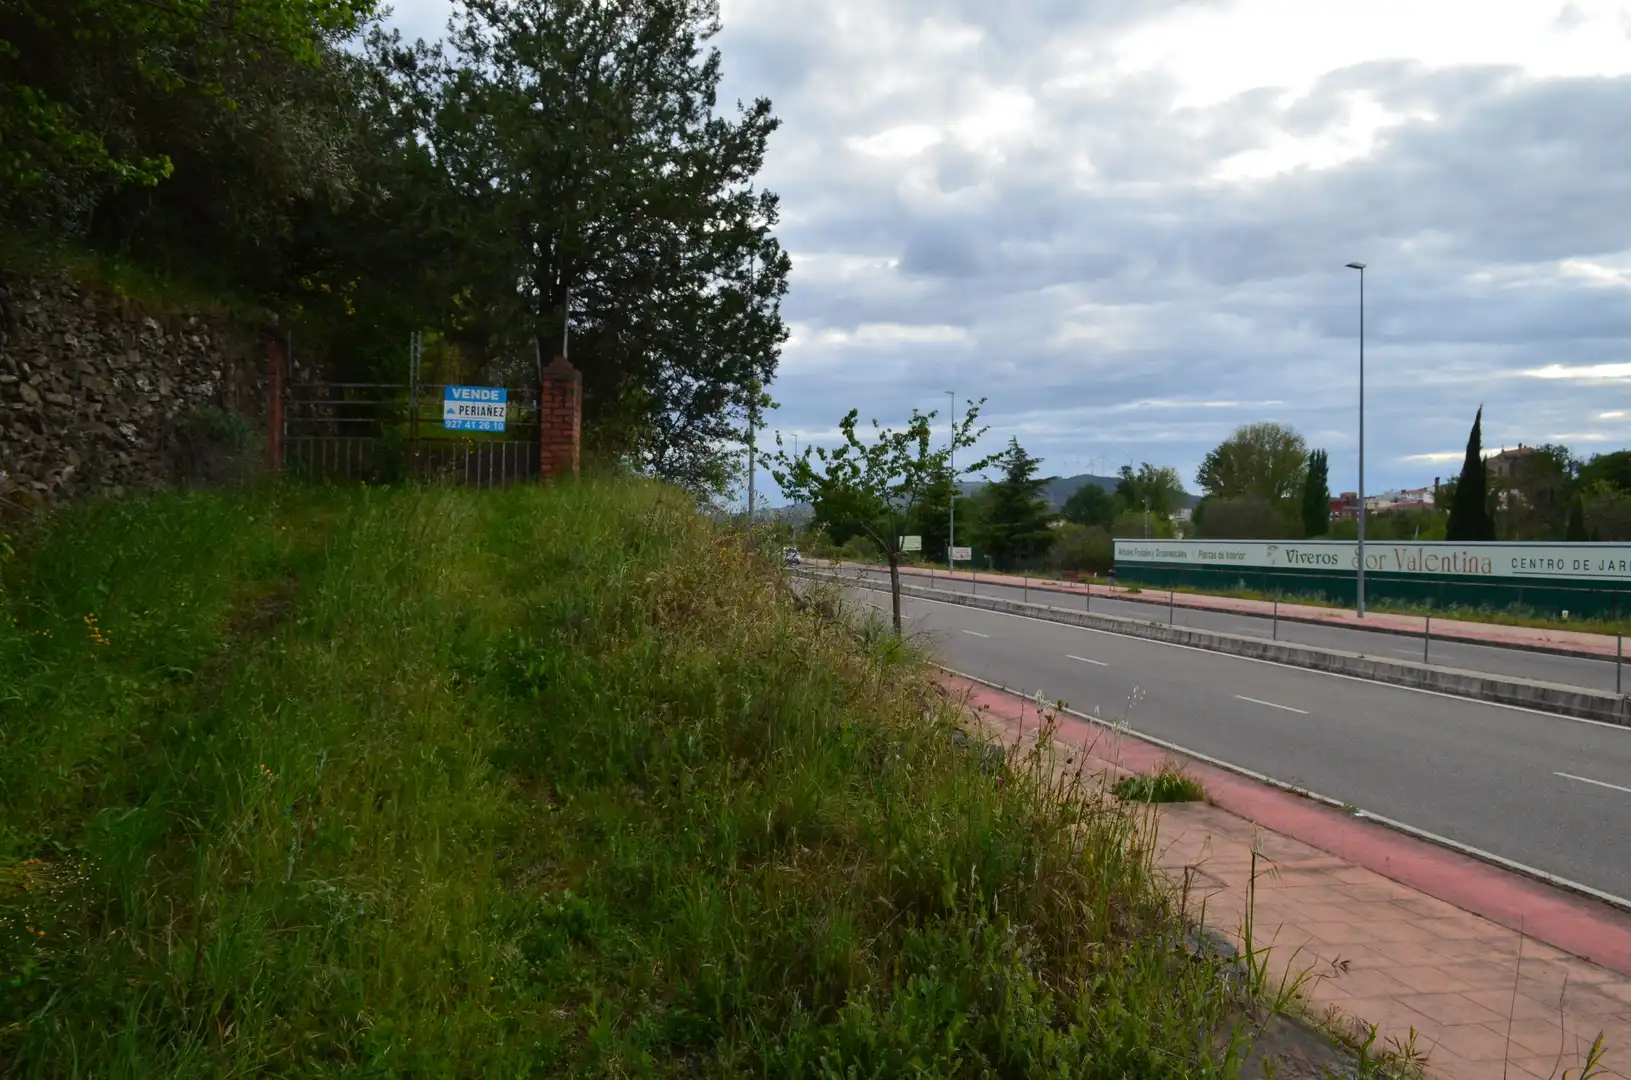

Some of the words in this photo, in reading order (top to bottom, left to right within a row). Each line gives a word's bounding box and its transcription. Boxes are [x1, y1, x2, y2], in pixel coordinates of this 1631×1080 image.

[452, 388, 500, 400] VENDE
[459, 405, 505, 417] PERIAÑEZ
[445, 420, 462, 429] 927
[464, 421, 476, 429] 41
[479, 421, 490, 430] 26
[493, 422, 504, 430] 10
[1285, 549, 1338, 565] Viveros
[1394, 548, 1492, 574] Valentina
[1511, 558, 1565, 570] CENTRO
[1573, 560, 1590, 571] DE
[1599, 560, 1631, 571] JAR
